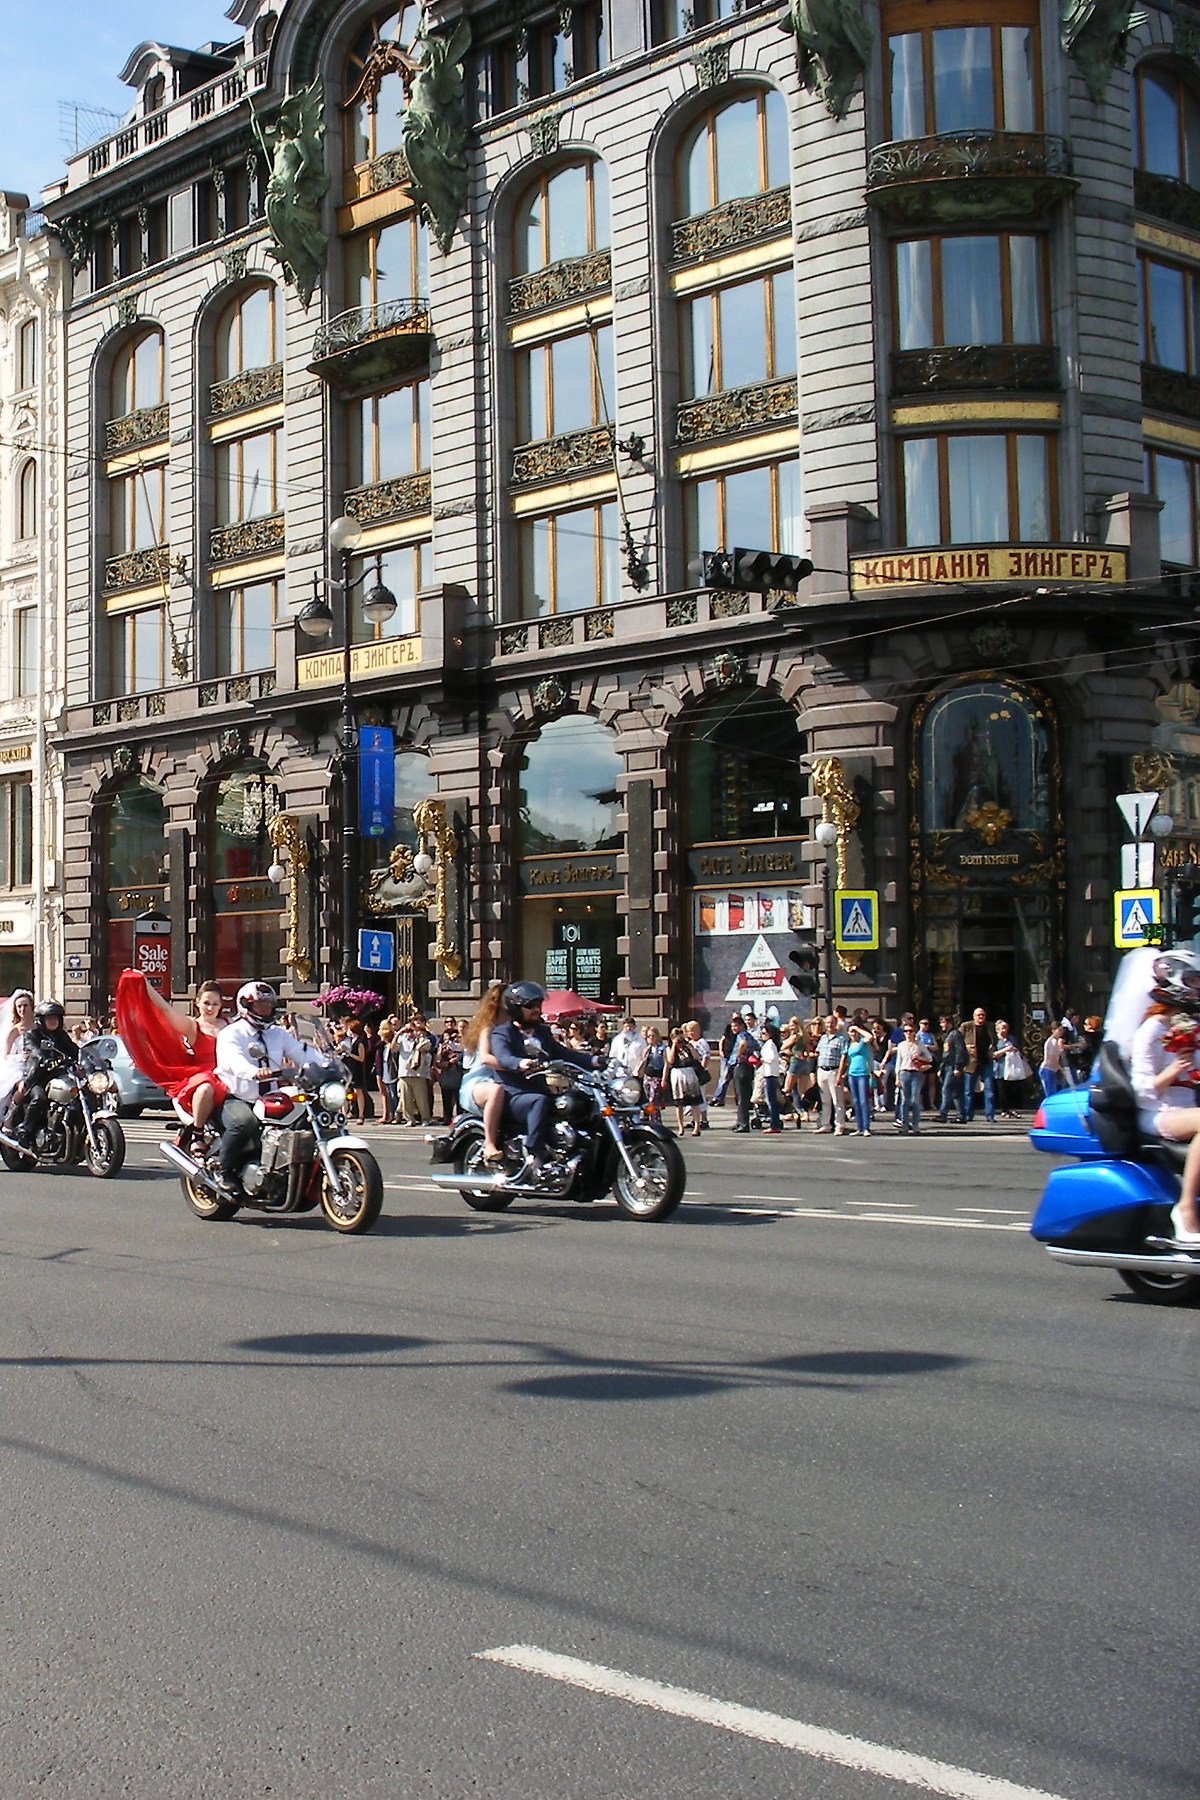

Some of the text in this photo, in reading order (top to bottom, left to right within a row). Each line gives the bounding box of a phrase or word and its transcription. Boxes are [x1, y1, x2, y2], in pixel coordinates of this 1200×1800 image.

[1008, 551, 1113, 579] ЗИНГЕРЪ
[305, 652, 359, 680] КОМПАЯ
[138, 944, 169, 962] Sale
[576, 956, 601, 966] GRANTS
[141, 960, 167, 973] 50%
